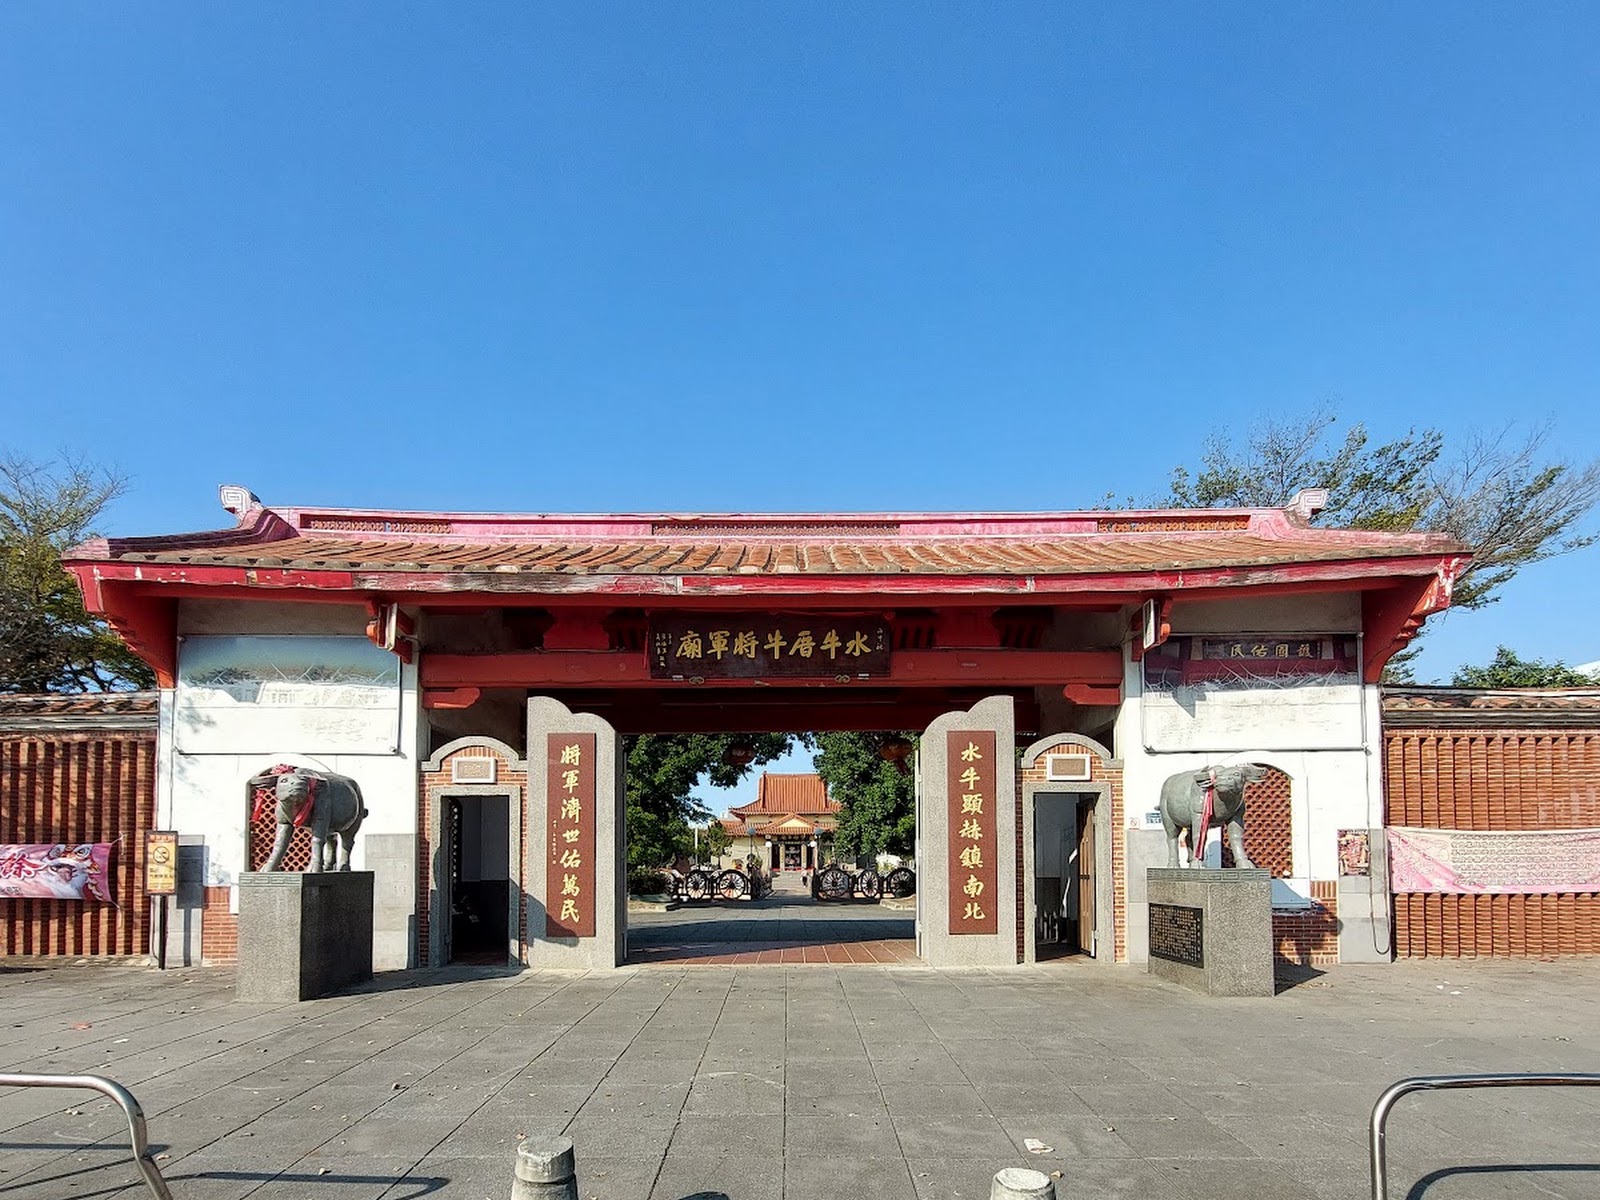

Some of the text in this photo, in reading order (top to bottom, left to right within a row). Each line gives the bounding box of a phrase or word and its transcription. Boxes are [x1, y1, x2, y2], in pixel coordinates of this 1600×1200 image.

[959, 741, 986, 920] 水牛顯赫鎮南北
